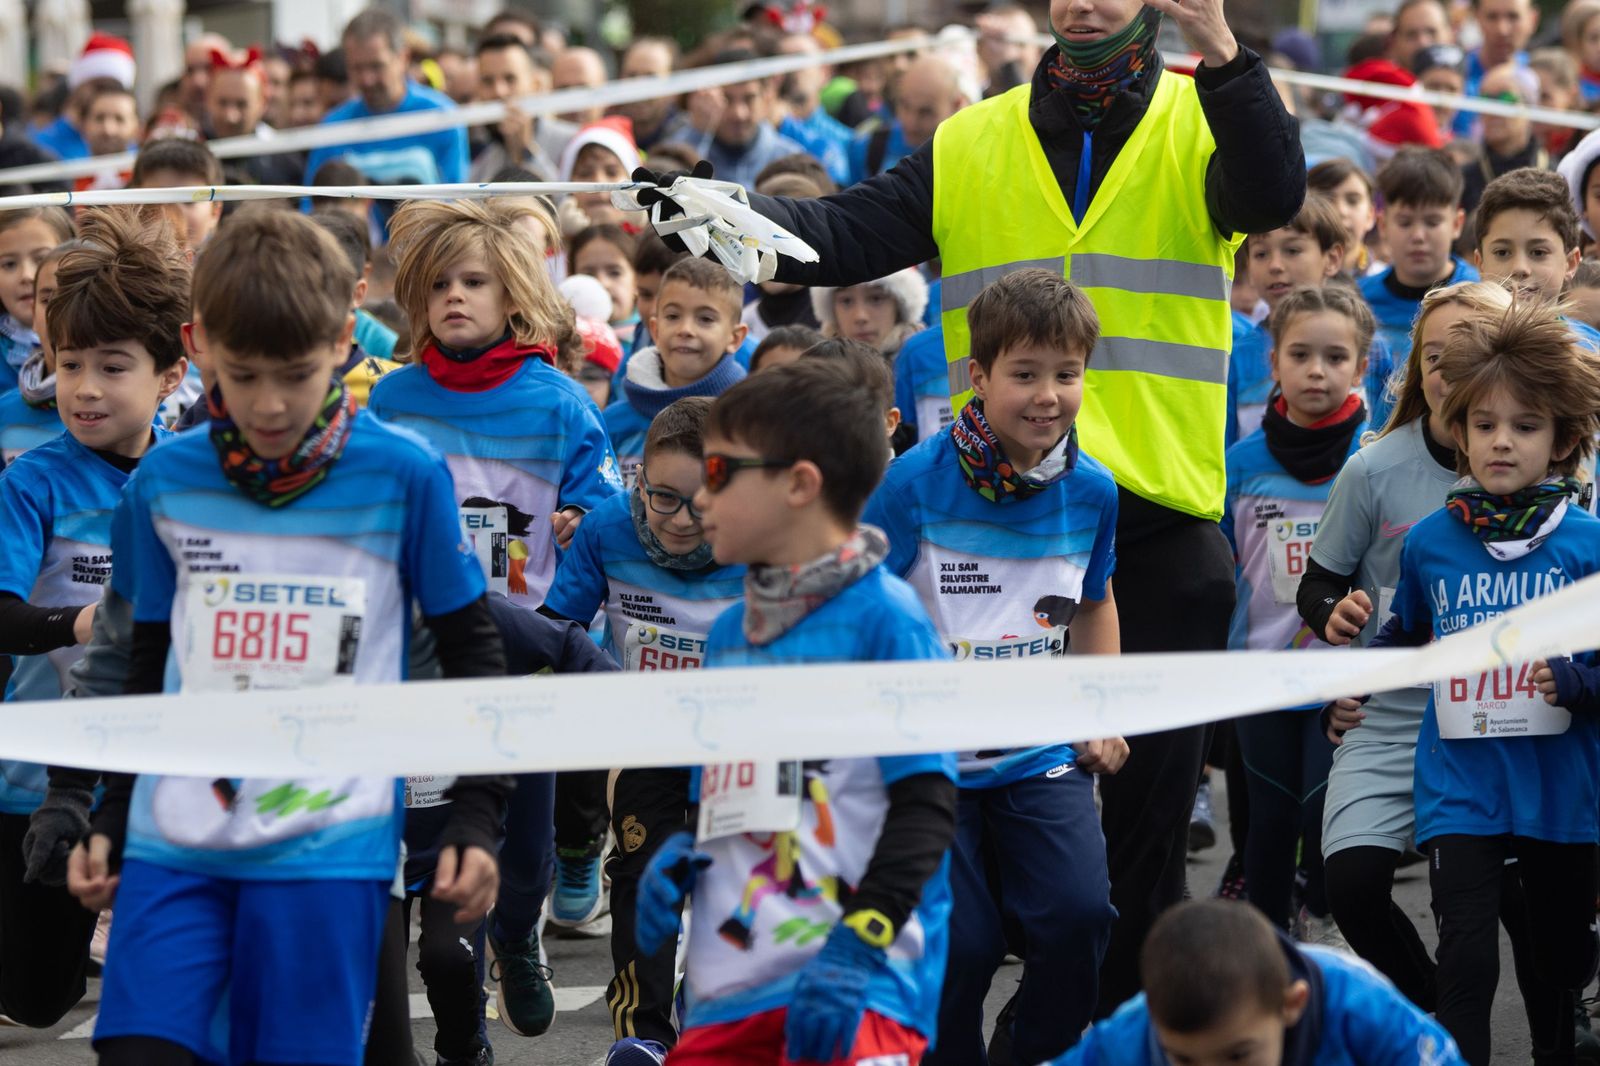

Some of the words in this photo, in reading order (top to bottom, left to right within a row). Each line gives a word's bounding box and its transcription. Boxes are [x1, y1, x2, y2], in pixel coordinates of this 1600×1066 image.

[72, 563, 112, 576] SILVEST
[940, 563, 956, 572] XLI
[958, 563, 978, 572] SAN
[940, 574, 989, 583] SILVESTRE
[234, 583, 346, 607] SETEL
[940, 585, 1002, 595] SALMANTINA
[1456, 567, 1566, 610] ARMUÑ
[619, 593, 632, 602] XLI
[634, 594, 653, 604] SAN
[621, 601, 662, 615] SILVESTRE
[622, 609, 676, 626] SALMANTINA
[1440, 613, 1468, 634] CLUB
[213, 611, 311, 662] 6815
[660, 633, 706, 654] SET
[974, 636, 1053, 661] SETEL
[1477, 701, 1507, 710] MARCO
[1490, 718, 1528, 726] Ayuntamiento
[406, 775, 434, 784] DRIGO
